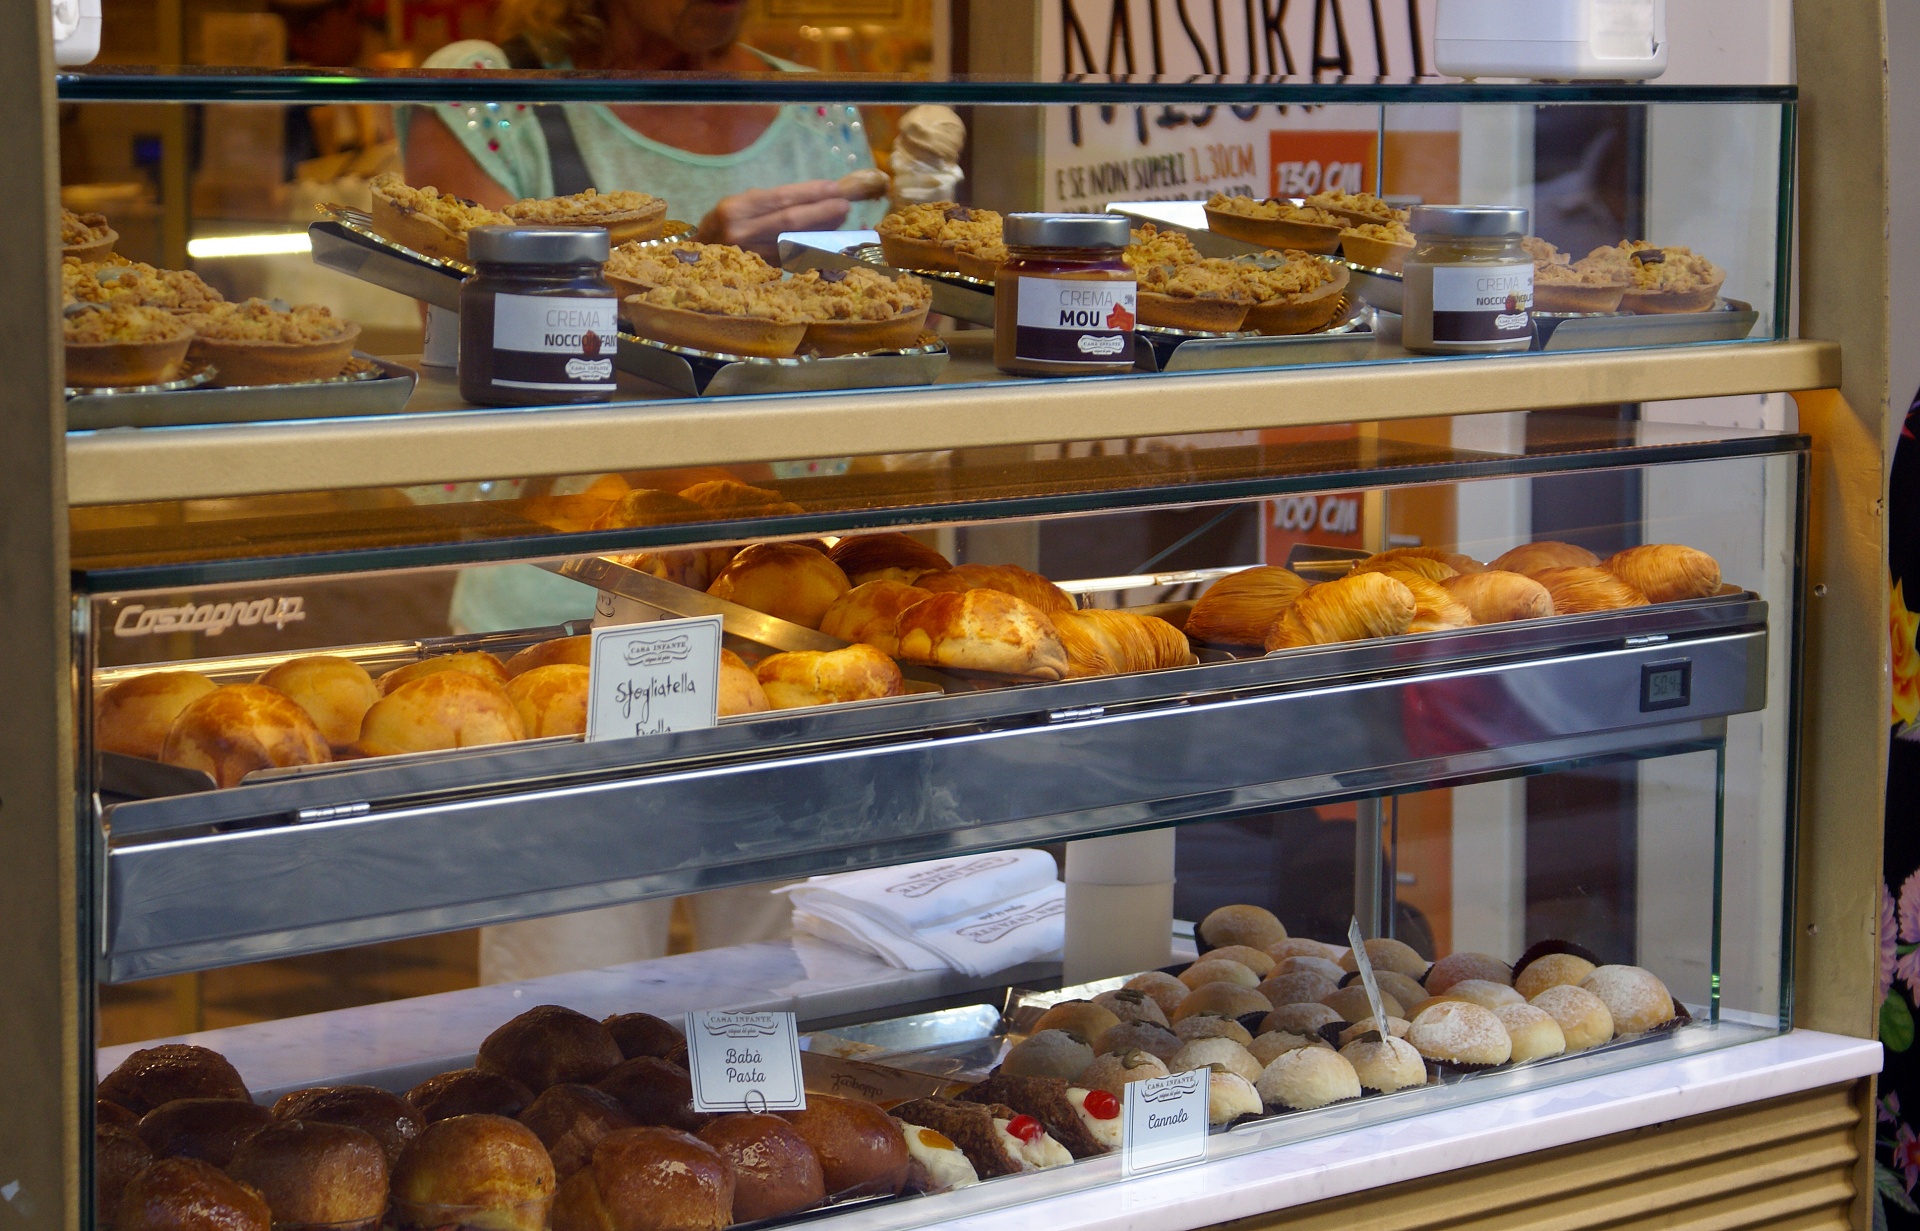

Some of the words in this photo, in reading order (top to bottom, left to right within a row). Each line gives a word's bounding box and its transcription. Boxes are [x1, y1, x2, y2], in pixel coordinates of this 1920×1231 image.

[1088, 159, 1129, 195] NON
[1476, 276, 1520, 292] CREMA
[1060, 289, 1113, 307] CREMA
[546, 309, 600, 327] CREMA
[1060, 309, 1100, 327] MOU
[1273, 496, 1318, 532] 100
[630, 645, 651, 654] CASA
[652, 641, 686, 652] INFANTE
[615, 672, 696, 724] Sfogliatella
[735, 1015, 772, 1023] INFANTE
[725, 1048, 763, 1064] Babà
[726, 1067, 767, 1083] Pasta
[1147, 1082, 1165, 1090] CASA
[1165, 1075, 1195, 1087] INFANTE
[1148, 1107, 1189, 1130] Cannolo
